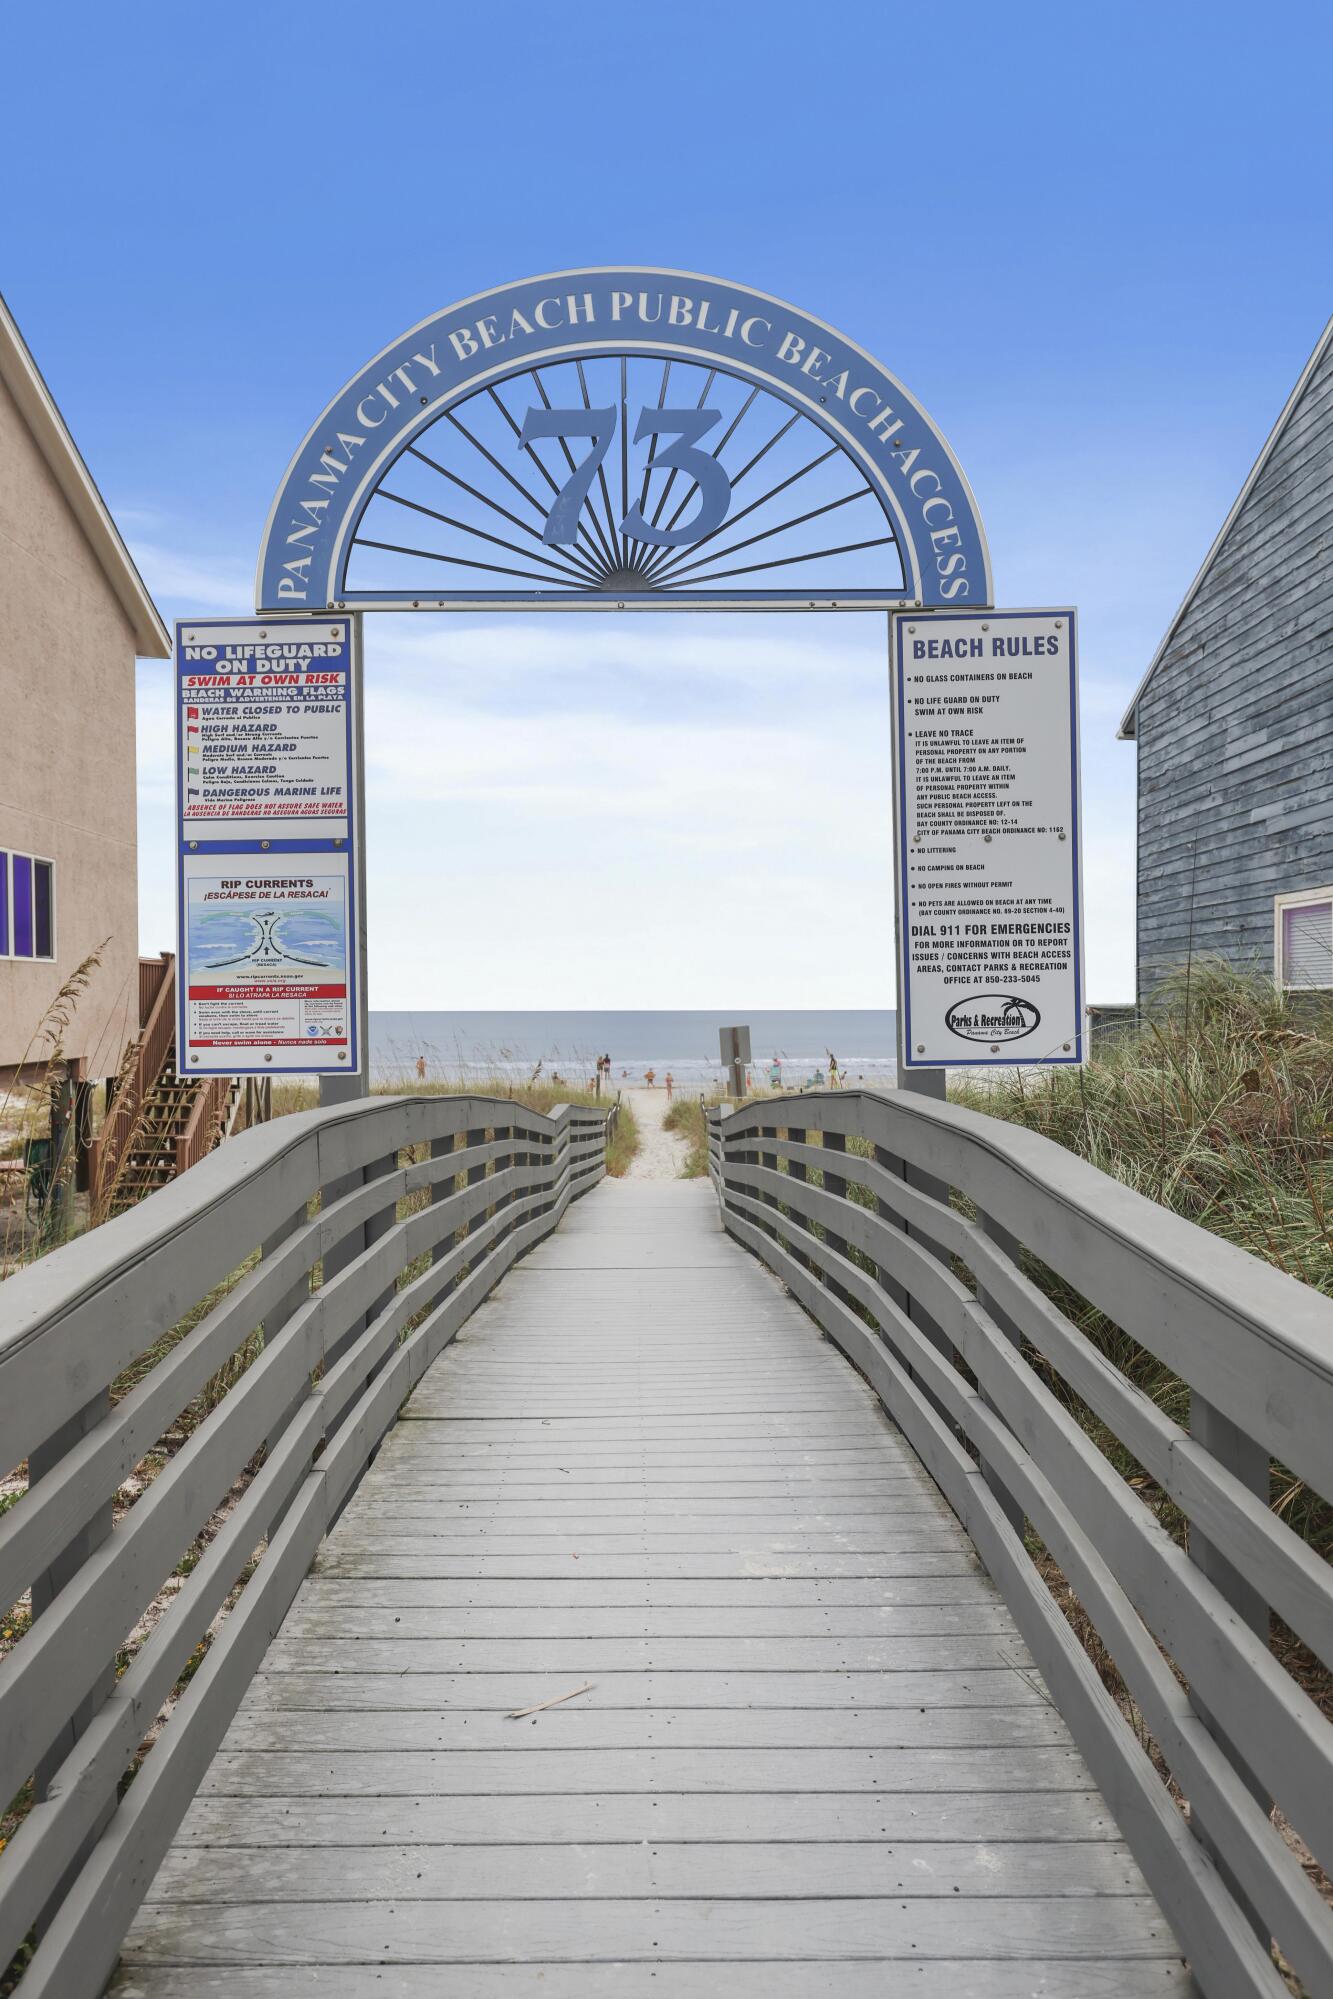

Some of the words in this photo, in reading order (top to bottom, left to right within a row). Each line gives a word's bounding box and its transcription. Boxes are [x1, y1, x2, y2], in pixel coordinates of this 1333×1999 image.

[278, 432, 366, 600] PANAMA
[356, 344, 441, 428] CITY
[448, 293, 595, 360] BEACH
[611, 291, 772, 347] PUBLIC
[776, 331, 904, 444] BEACH
[891, 448, 969, 598] ACCESS
[518, 402, 731, 547] 73
[185, 646, 217, 660] NO
[225, 643, 342, 659] LIFEGUARD
[913, 638, 983, 659] BEACH
[992, 635, 1059, 657] RULES
[215, 659, 248, 673] ON
[256, 658, 312, 672] DUTY
[187, 675, 231, 686] SWIM
[236, 675, 256, 685] AT
[260, 674, 299, 685] OWN
[304, 673, 340, 684] RISK
[950, 673, 994, 681] CONTAINERS
[181, 688, 224, 697] BEACH
[230, 687, 297, 696] WARNING
[303, 686, 345, 695] FLAGS
[943, 696, 967, 704] GUARD
[201, 706, 238, 716] WATER
[242, 705, 282, 715] CLOSED
[286, 705, 300, 714] TO
[303, 704, 341, 713] PUBLIC
[200, 724, 228, 733] HIGH
[231, 723, 277, 732] HAZARD
[202, 744, 247, 753] MEDIUM
[251, 743, 297, 752] HAZARD
[202, 766, 228, 774] LOW
[231, 765, 276, 774] HAZARD
[202, 788, 270, 797] DANGEROUS
[273, 787, 317, 796] MARINE
[320, 786, 342, 795] LIFE
[221, 880, 241, 889] RIP
[245, 879, 313, 888] CURRENTS
[203, 891, 256, 900] ¡ESCÁPESE
[258, 891, 271, 899] DE
[273, 890, 285, 899] LA
[911, 925, 936, 936] DIAL
[939, 925, 960, 935] 911
[964, 924, 987, 935] FOR
[990, 922, 1071, 934] EMERGENCIES
[932, 940, 954, 948] MORE
[957, 939, 1010, 948] INFORMATION
[1037, 938, 1068, 946] REPORT
[912, 953, 939, 961] ISSUES
[947, 952, 988, 960] CONCERNS
[990, 951, 1011, 959] WITH
[1013, 951, 1038, 959] BEACH
[1040, 950, 1071, 958] ACCESS
[916, 965, 944, 973] AREAS,
[946, 964, 981, 972] CONTACT
[983, 964, 1008, 972] PARKS
[1011, 963, 1016, 971] &
[1019, 962, 1067, 971] RECREATION
[943, 976, 971, 984] OFFICE
[985, 975, 1040, 983] 850-233-5045
[951, 1015, 972, 1027] Parks
[980, 1014, 1020, 1026] Recreation
